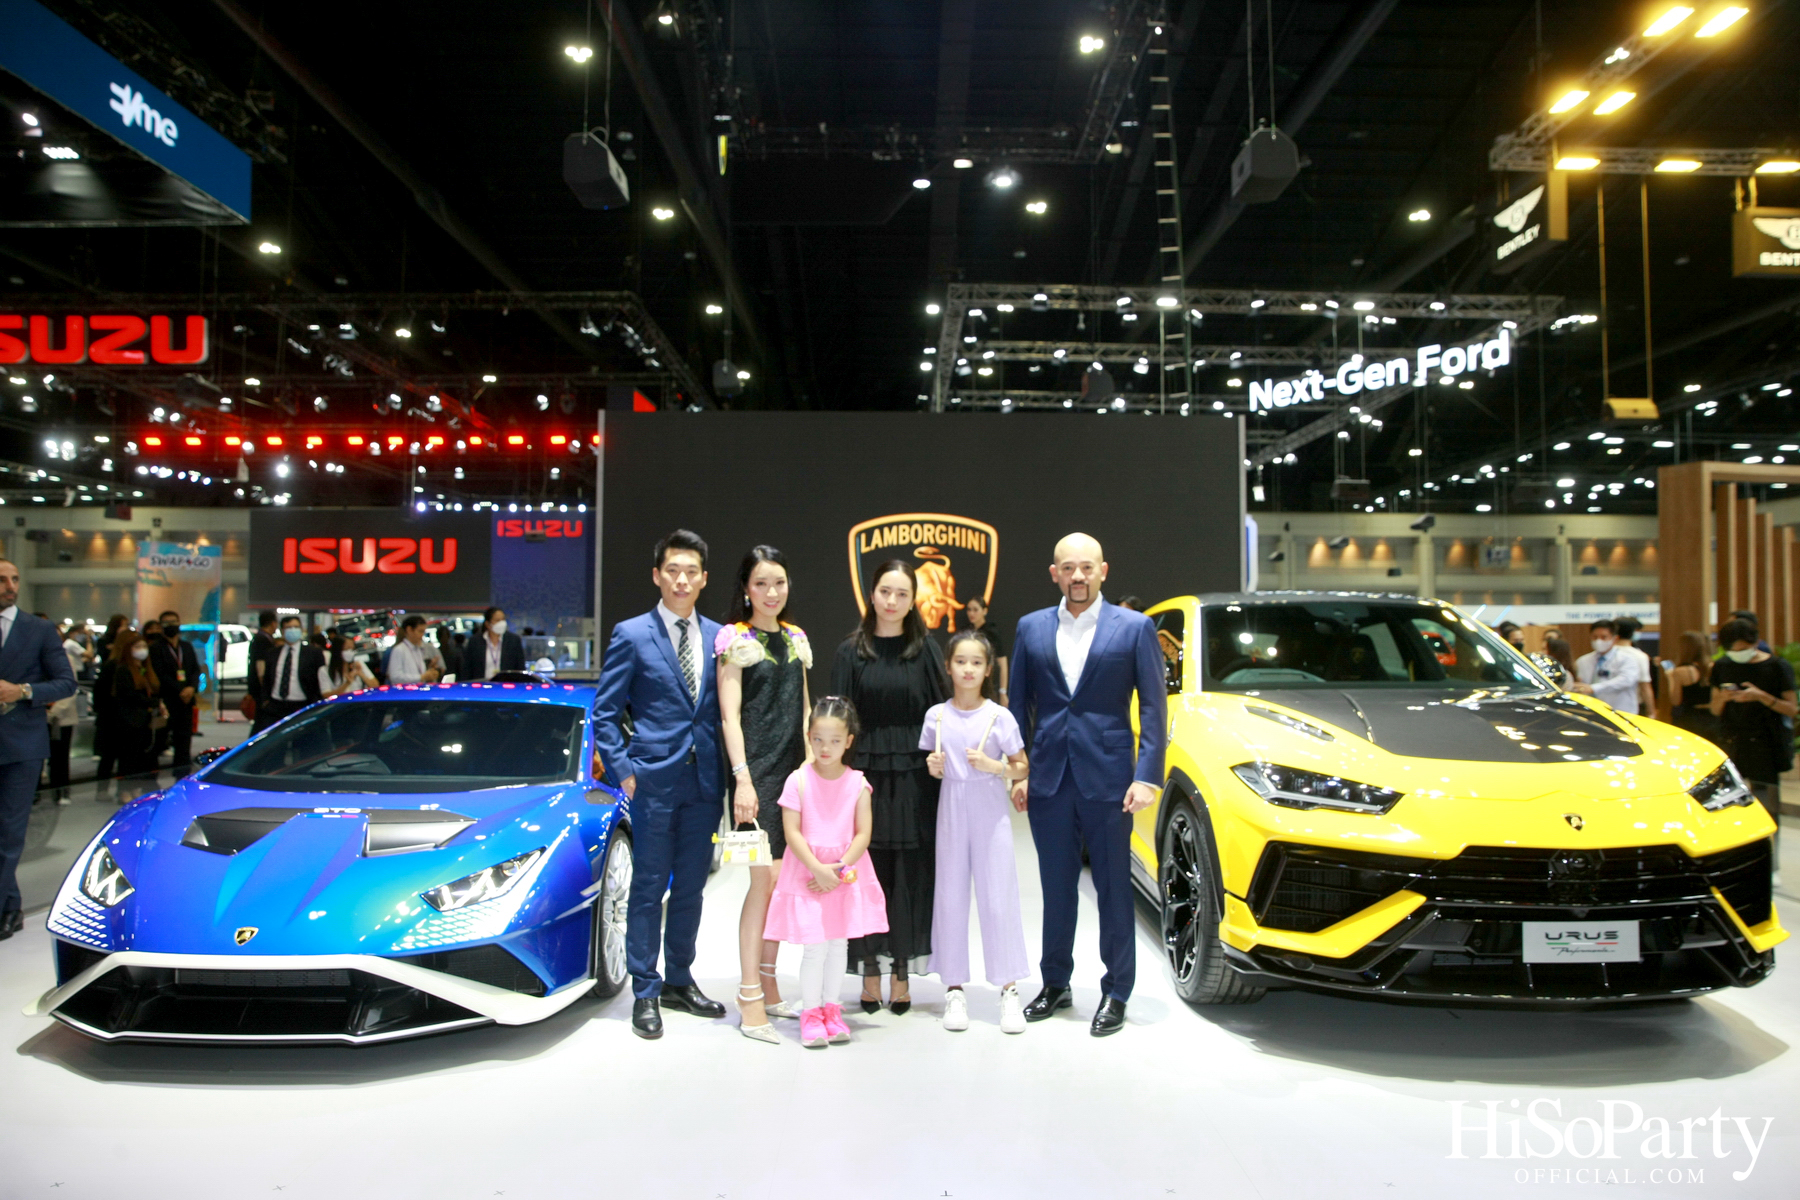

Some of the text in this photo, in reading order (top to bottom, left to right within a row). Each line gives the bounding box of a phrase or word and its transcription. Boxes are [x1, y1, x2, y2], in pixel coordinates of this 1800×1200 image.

[1497, 223, 1541, 260] BENTLEY
[1249, 329, 1510, 412] Next-Gen Ford
[497, 519, 584, 538] ISUZU
[860, 522, 987, 555] LAMBORGHINI
[283, 537, 458, 574] ISUZU
[1544, 930, 1619, 941] URUS
